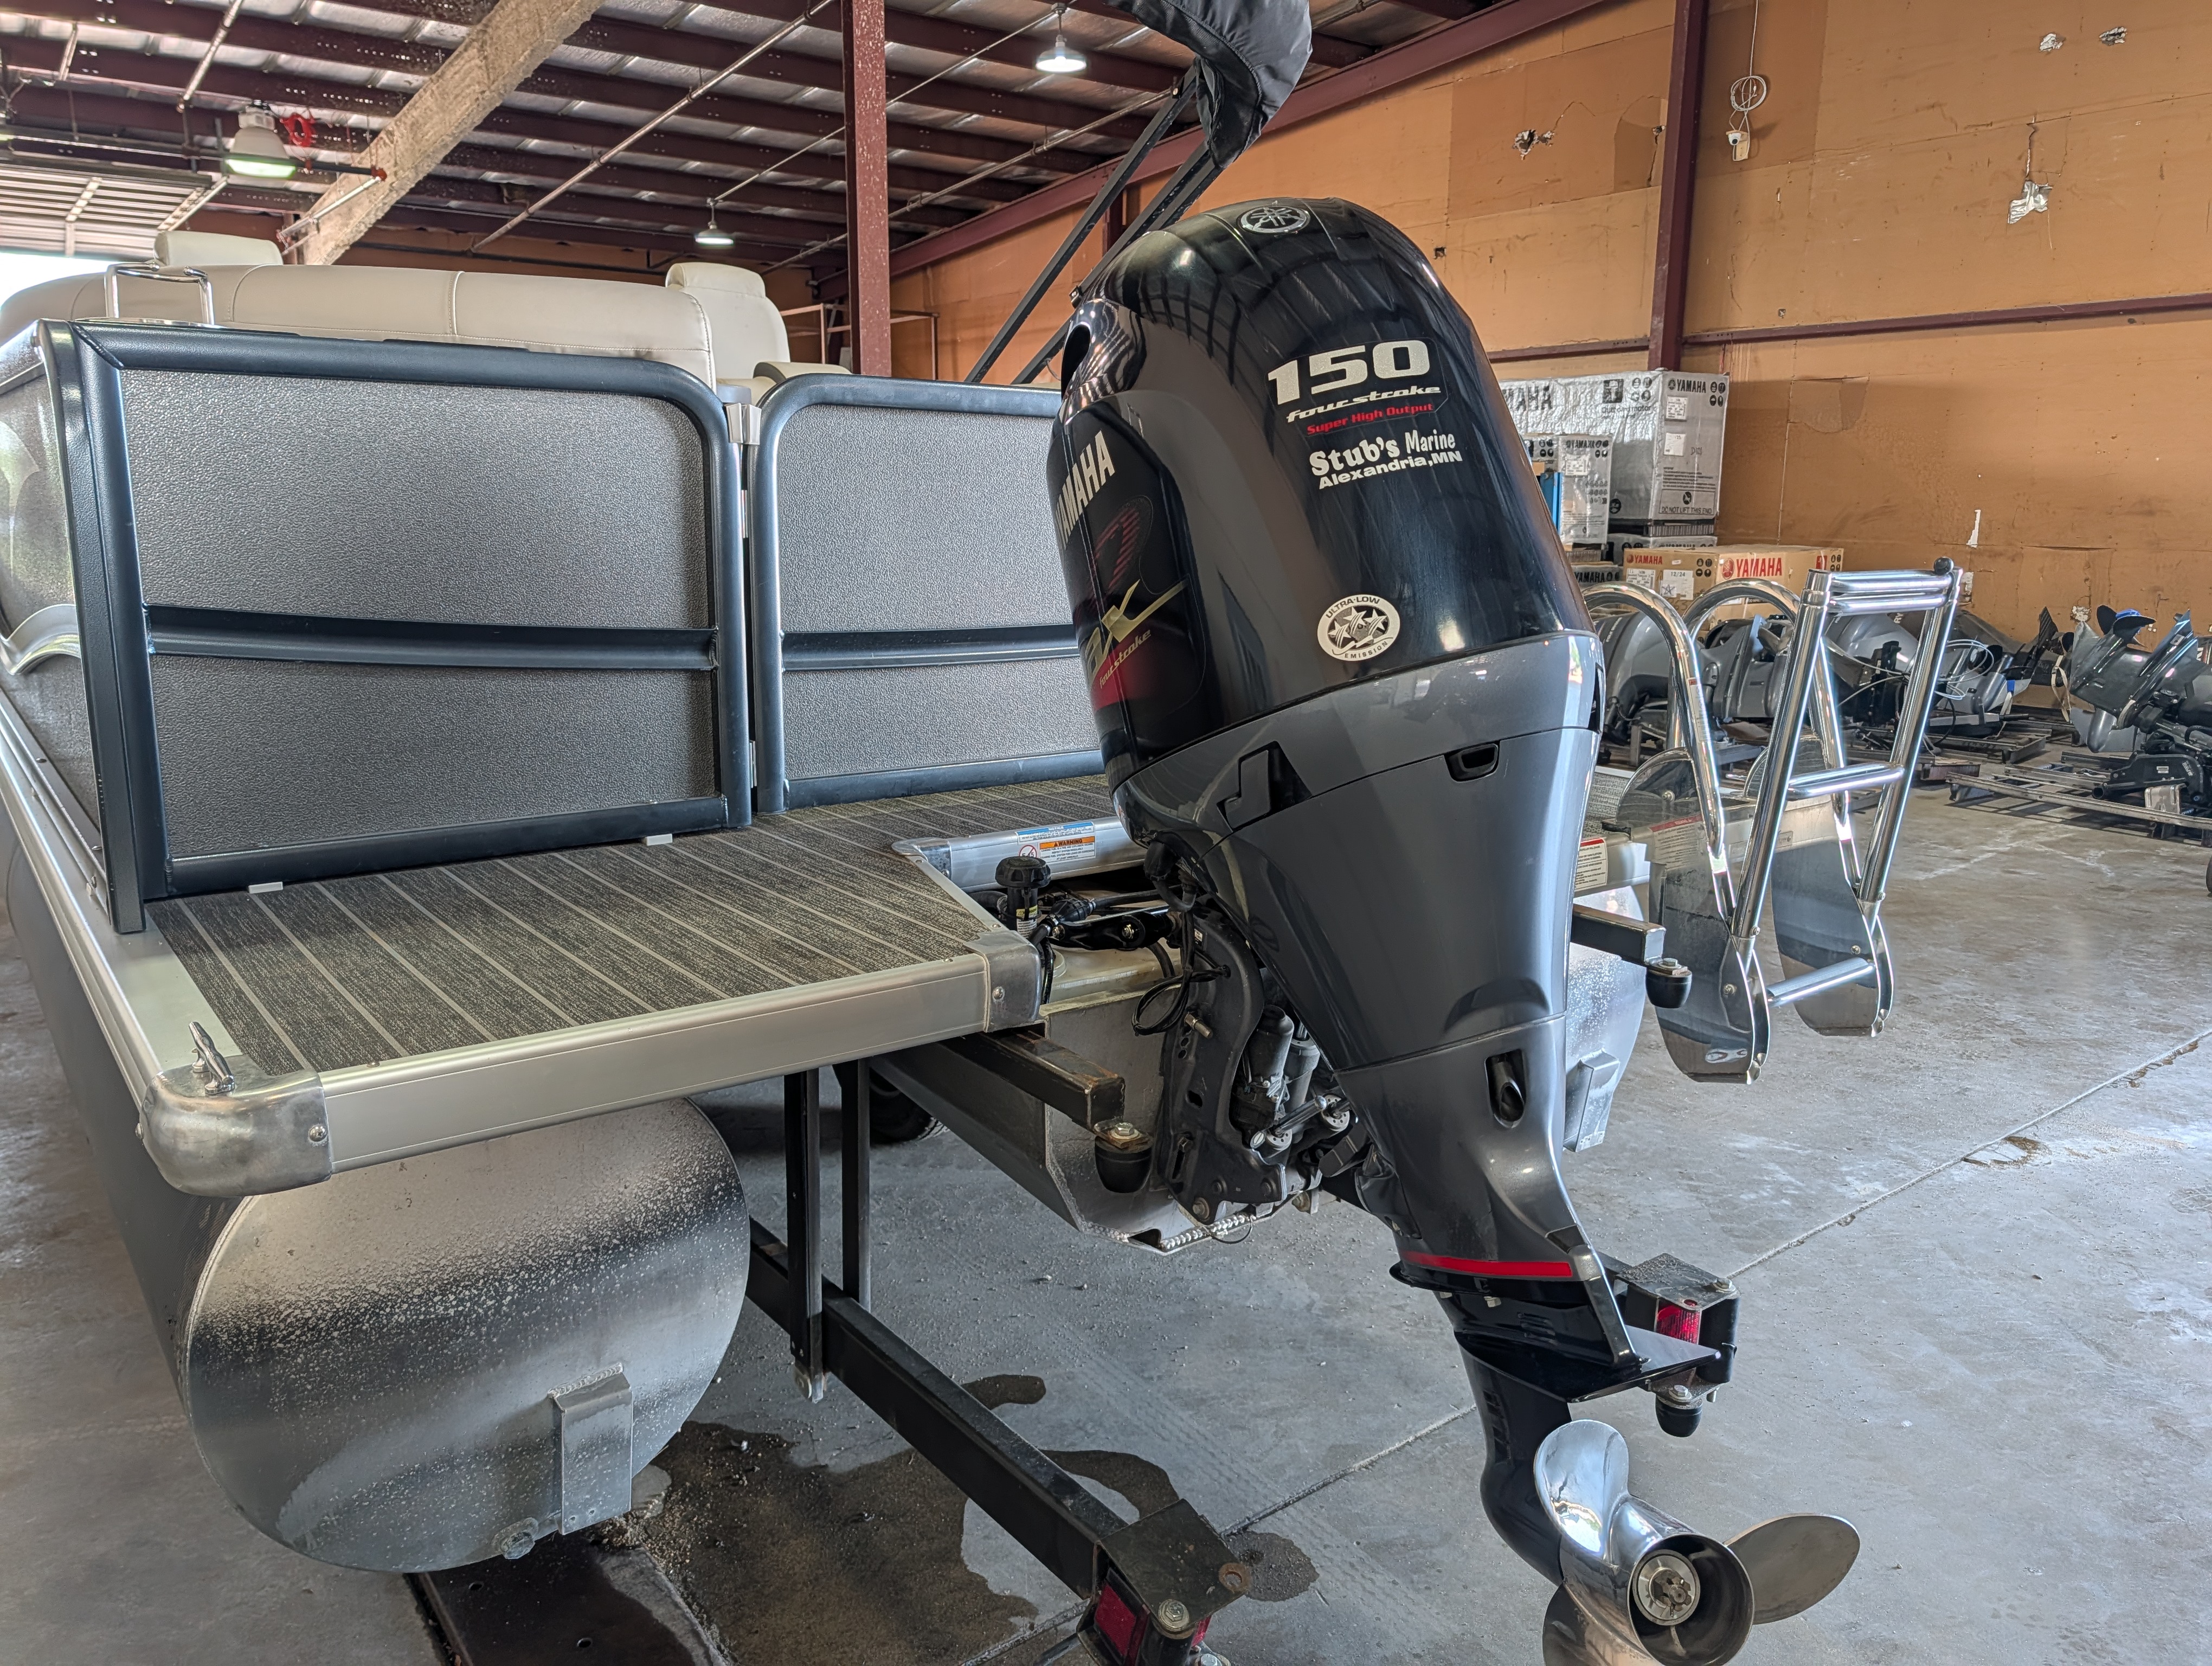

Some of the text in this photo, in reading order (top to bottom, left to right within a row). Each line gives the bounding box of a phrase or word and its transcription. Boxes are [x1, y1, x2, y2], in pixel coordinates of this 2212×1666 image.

[1268, 339, 1430, 405] 150
[1677, 379, 1706, 393] YAMAHA
[1307, 403, 1433, 435] Super High Output
[1309, 428, 1456, 476] Stub's Marine
[1572, 439, 1594, 448] YAMAHA
[1634, 554, 1663, 565] YAMAHA
[1736, 557, 1782, 578] YAMAHA
[1574, 571, 1605, 583] YAMAHA
[1344, 641, 1388, 659] EMISSION
